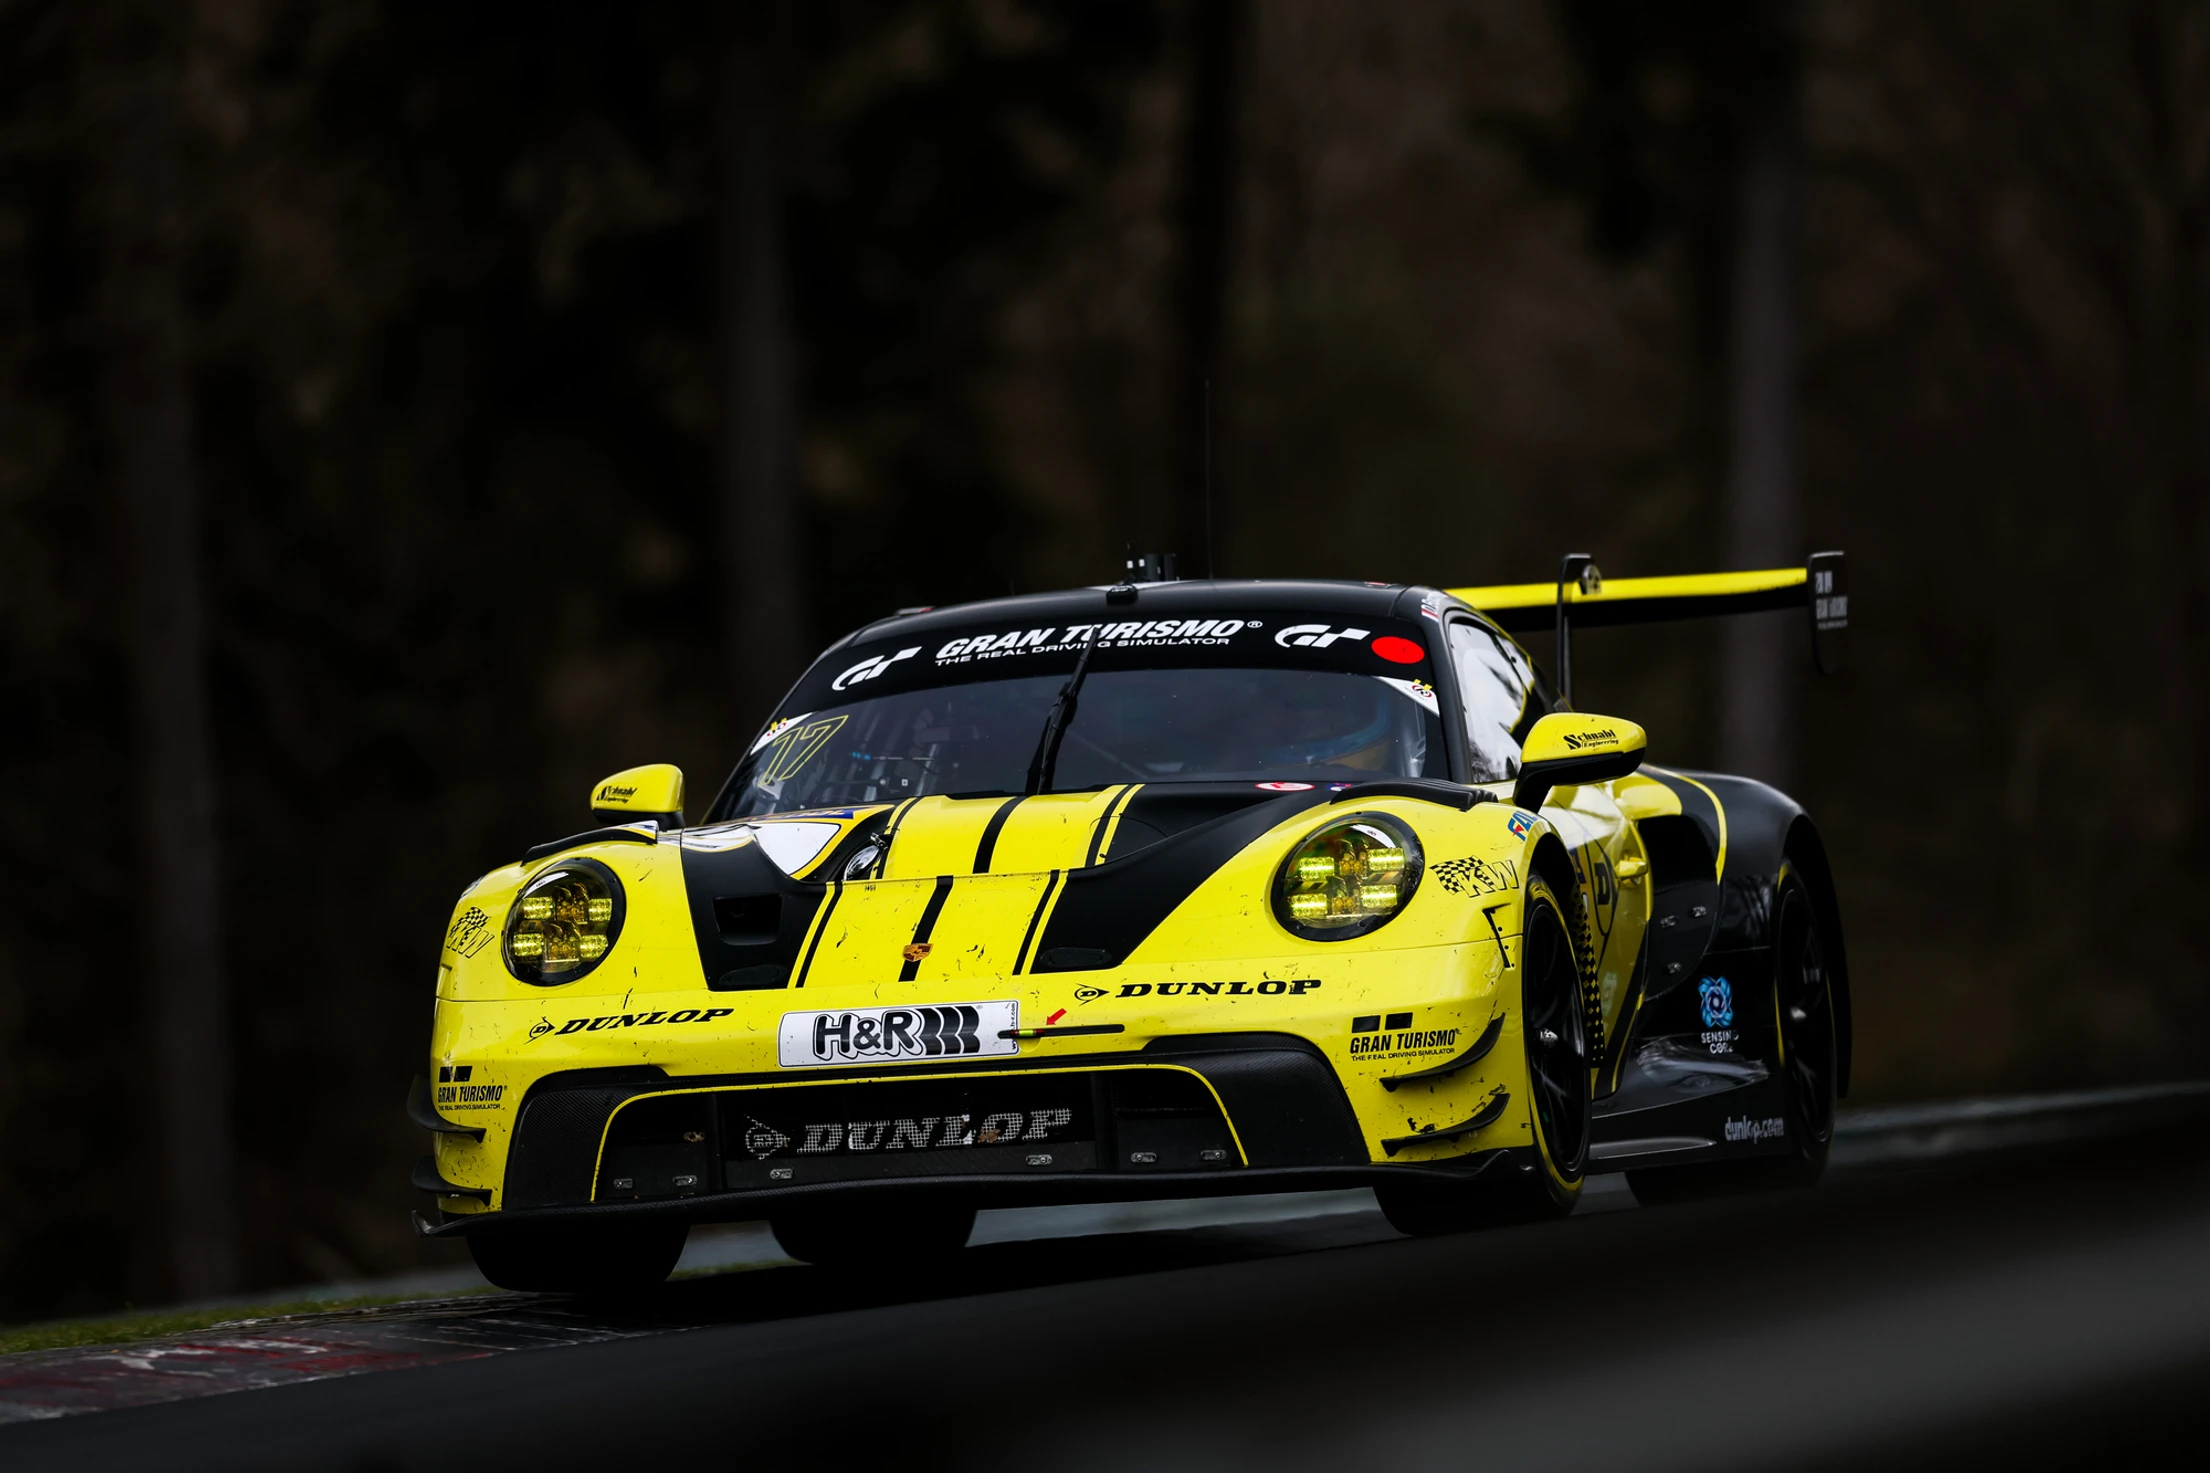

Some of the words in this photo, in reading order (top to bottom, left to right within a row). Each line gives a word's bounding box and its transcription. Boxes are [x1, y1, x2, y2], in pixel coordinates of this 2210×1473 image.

[935, 627, 1057, 659] GRAN
[1060, 619, 1246, 645] TURISMO
[935, 654, 973, 666] THE
[977, 648, 1027, 660] REAL
[1031, 640, 1111, 654] DRIVIG
[1117, 637, 1231, 648] SIMULATOR
[757, 714, 849, 787] 17
[1563, 729, 1617, 750] Schnabl
[1452, 859, 1520, 899] KW
[1115, 979, 1322, 998] DUNLOP
[554, 1008, 735, 1036] DUNLOP
[813, 1009, 924, 1061] H&R
[1349, 1034, 1392, 1054] GRAN
[1397, 1028, 1457, 1050] TURISMO
[1418, 1047, 1455, 1055] SIMULATOR
[438, 1086, 458, 1103] GRAN
[459, 1084, 503, 1102] TURISMO
[797, 1107, 1072, 1154] DUNLOP
